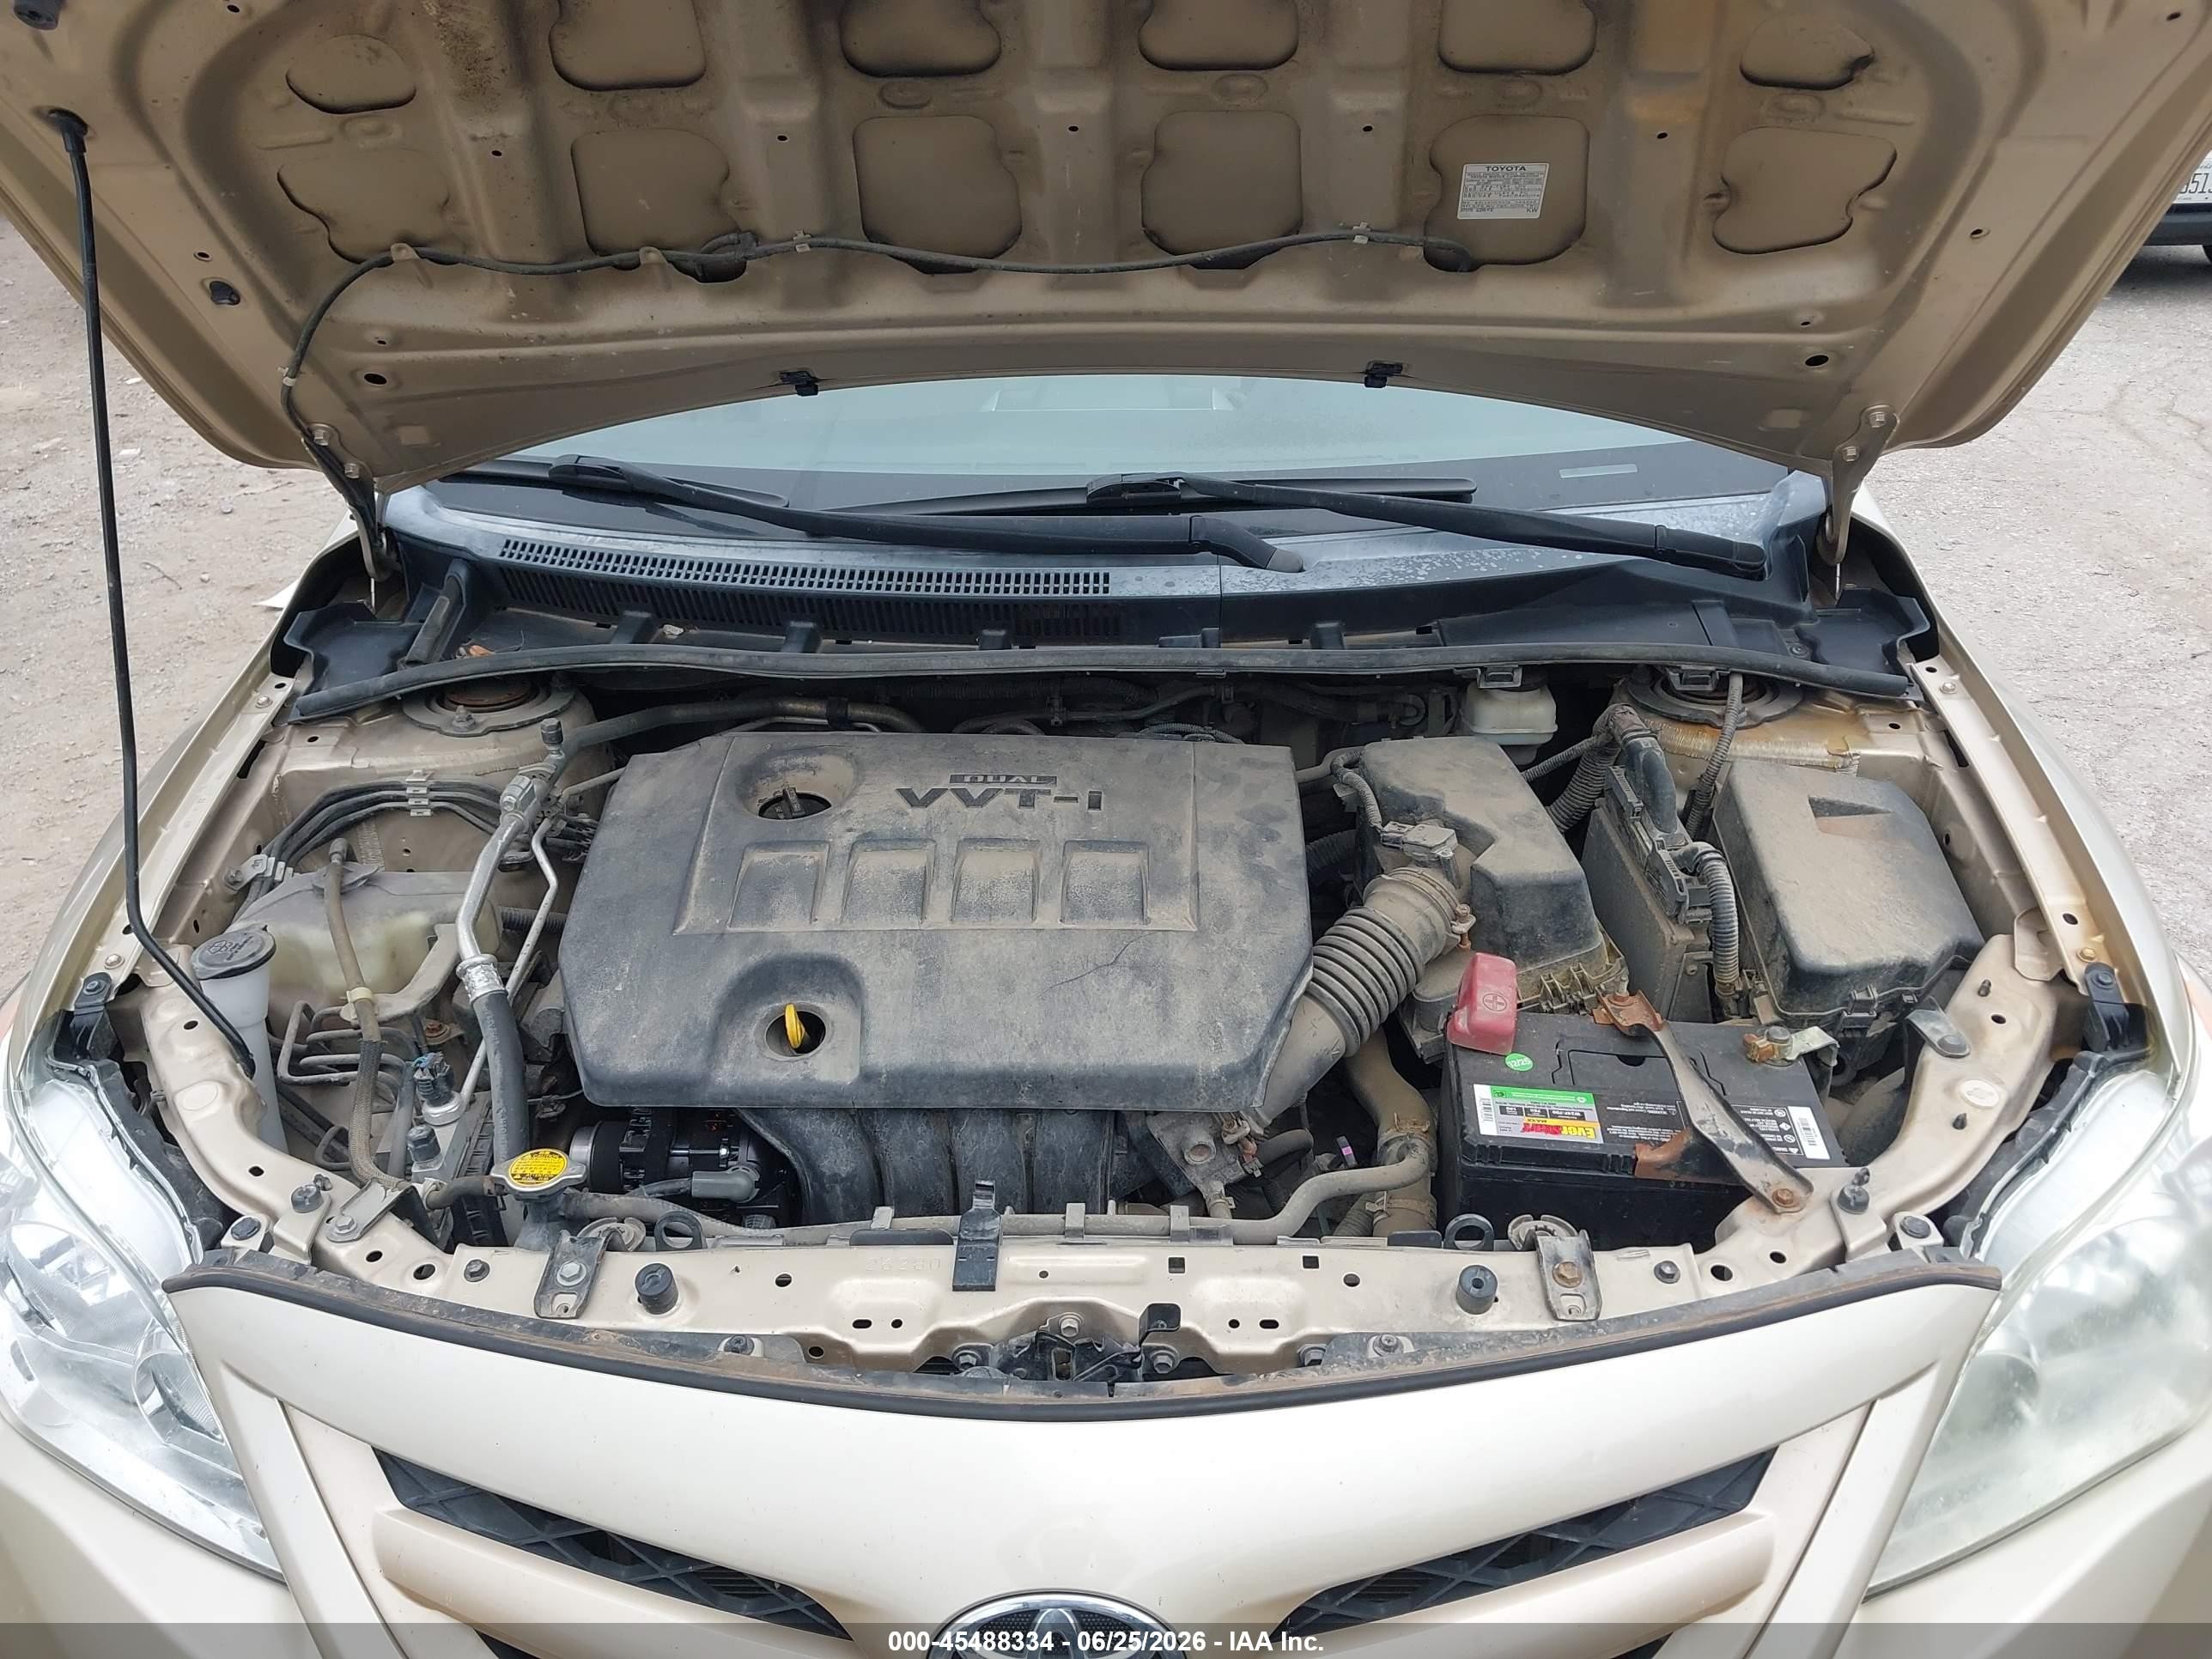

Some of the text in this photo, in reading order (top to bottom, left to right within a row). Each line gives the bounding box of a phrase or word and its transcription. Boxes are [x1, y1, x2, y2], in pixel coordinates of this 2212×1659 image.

[963, 775, 1056, 784] DUAL
[1507, 1057, 1529, 1067] 12/25
[1521, 1122, 1595, 1139] EverStart
